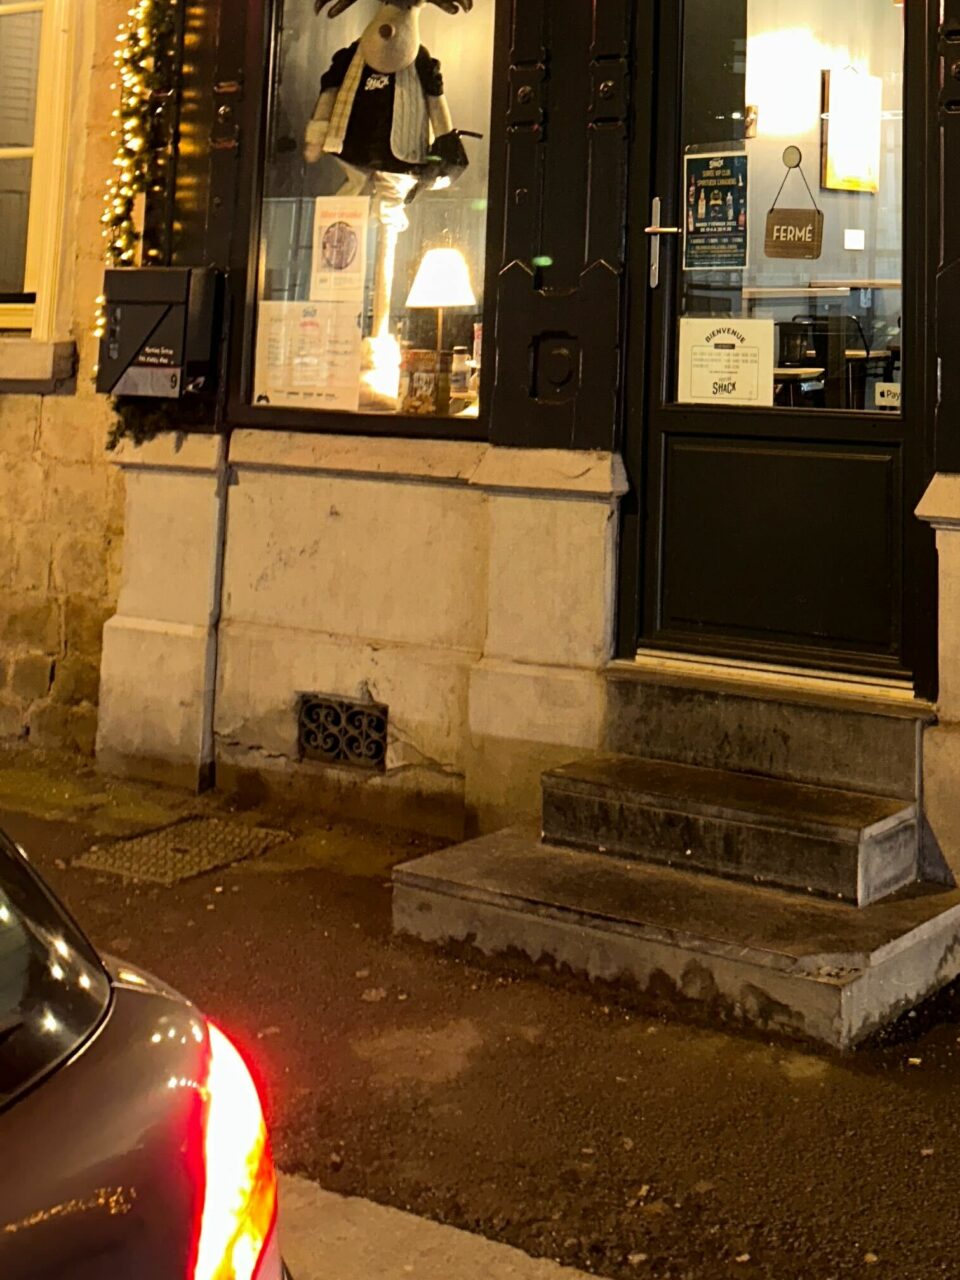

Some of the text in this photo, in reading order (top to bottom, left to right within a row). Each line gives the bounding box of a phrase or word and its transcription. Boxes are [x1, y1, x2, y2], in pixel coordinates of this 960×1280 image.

[773, 224, 813, 241] FERMÉ
[705, 327, 746, 344] BIENVENUE
[170, 373, 178, 389] 9
[712, 381, 737, 395] SHACK
[886, 389, 902, 401] Pay
